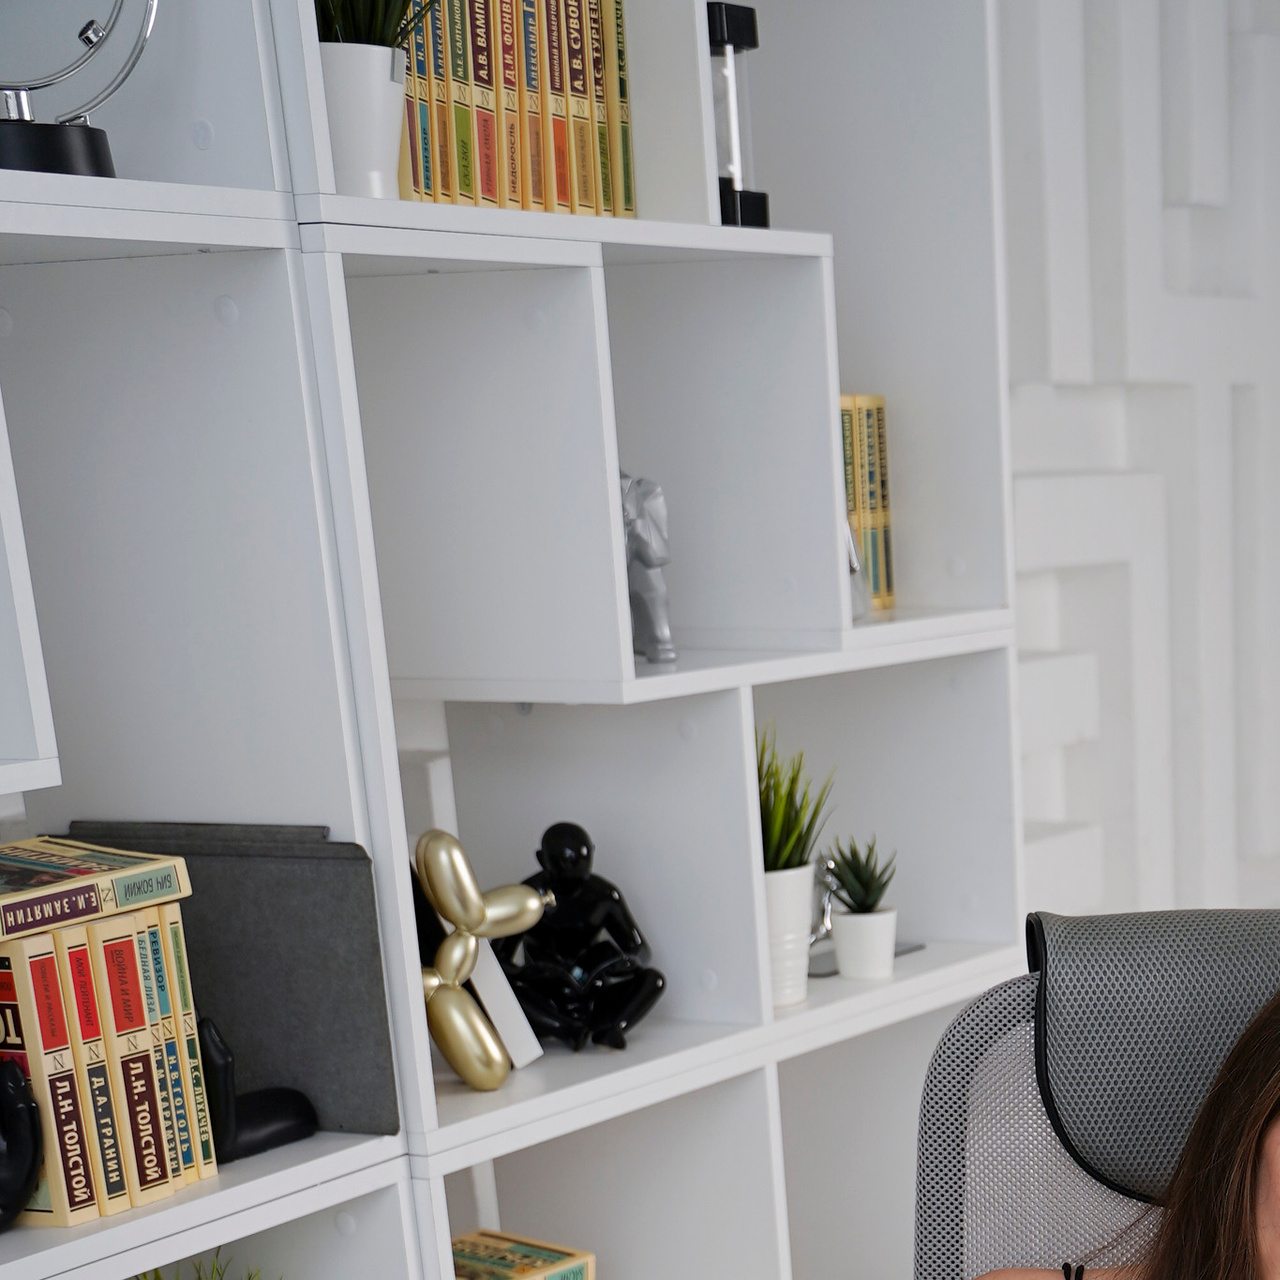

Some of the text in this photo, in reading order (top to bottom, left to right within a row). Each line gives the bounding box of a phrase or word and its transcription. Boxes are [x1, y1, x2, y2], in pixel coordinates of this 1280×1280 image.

[509, 123, 517, 193] НЕДОРОСЛЬ
[6, 898, 70, 927] ЗАМЯТИН
[124, 874, 172, 901] БИЧ БОЖИЙ
[115, 949, 128, 986] ВОЙНА
[122, 999, 134, 1022] МИР
[138, 940, 155, 1013] БЕДНАЯ ЛИЗА
[150, 932, 165, 992] РЕВИЗОР
[100, 1118, 120, 1183] ГРАНИН
[136, 1100, 162, 1181] ТОЛСТОЙ
[159, 1091, 178, 1169] КАРАМЗИН
[173, 1087, 189, 1152] ГОГОЛЬ
[63, 1120, 90, 1203] ТОЛСТОЙ
